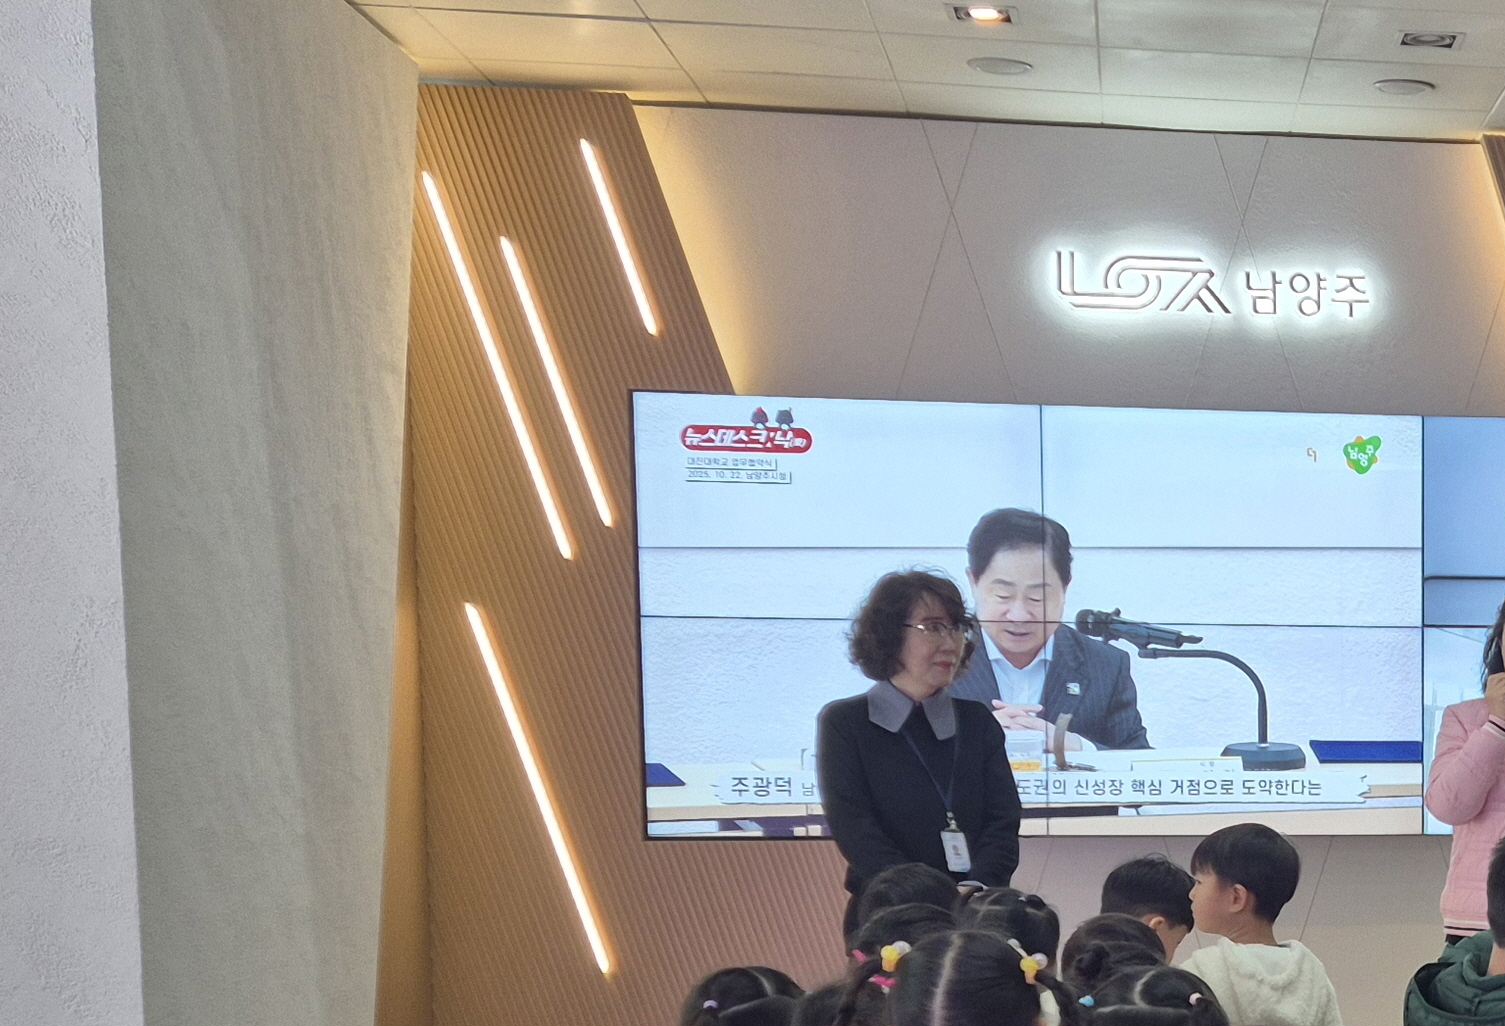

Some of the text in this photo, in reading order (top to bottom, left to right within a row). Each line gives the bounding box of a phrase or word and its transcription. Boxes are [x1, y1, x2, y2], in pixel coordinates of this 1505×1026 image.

[1244, 268, 1371, 318] 남양주
[730, 776, 793, 798] 주광덕
[1074, 779, 1125, 796] 신성장
[1130, 779, 1162, 796] 핵심
[1169, 779, 1234, 796] 거점으로
[1241, 779, 1323, 796] 도약한다는
